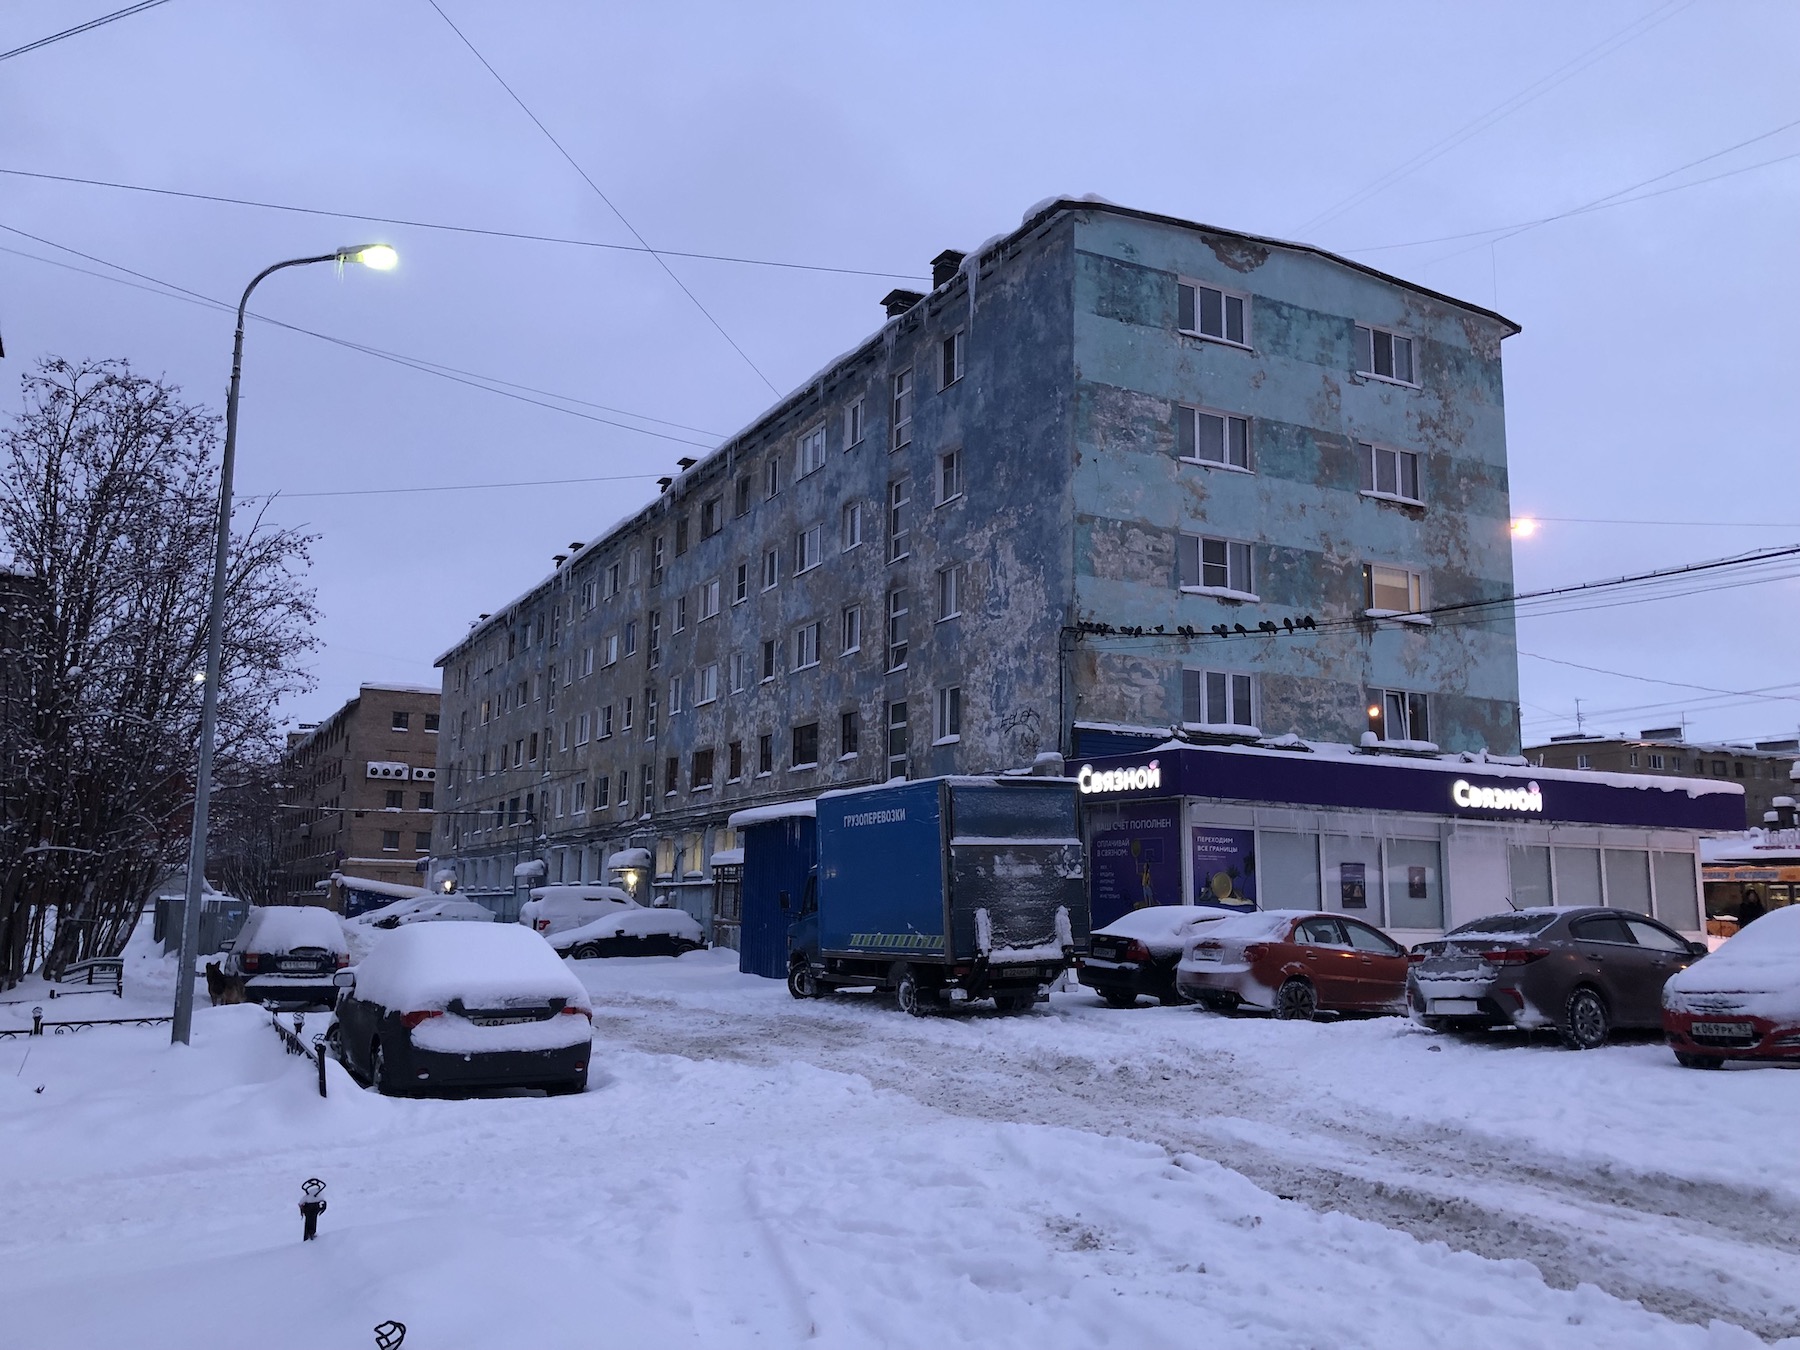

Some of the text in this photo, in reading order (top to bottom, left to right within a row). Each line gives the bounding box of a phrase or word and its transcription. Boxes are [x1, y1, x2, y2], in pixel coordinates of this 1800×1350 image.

[843, 808, 906, 828] ГРУЗОПЕРЕВОЗКИ
[1130, 818, 1172, 829] ПОПОЛНЕН
[1096, 838, 1130, 848] ОПЛАЧИВАЙ
[1197, 836, 1233, 844] ПЕРЕХОДИМ
[1209, 846, 1238, 854] ГРАНИЦЫ
